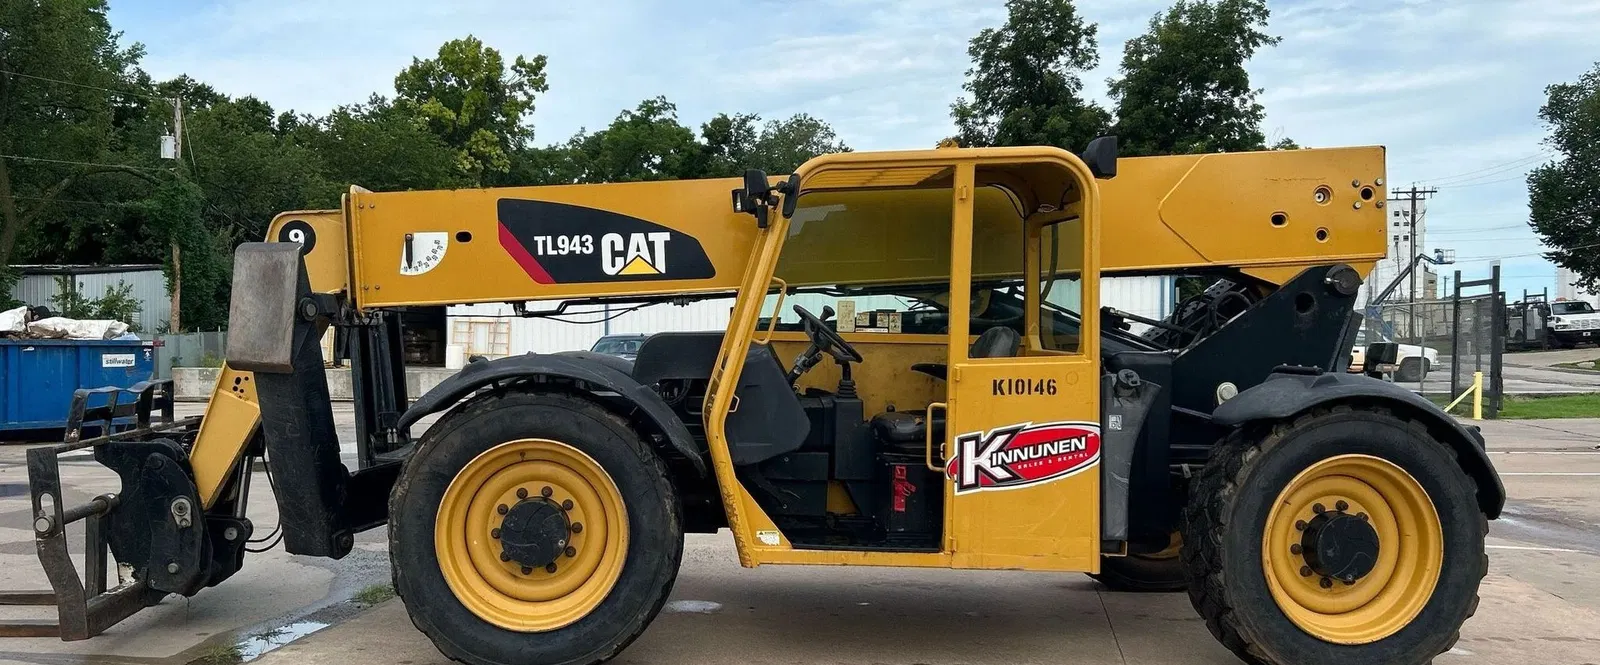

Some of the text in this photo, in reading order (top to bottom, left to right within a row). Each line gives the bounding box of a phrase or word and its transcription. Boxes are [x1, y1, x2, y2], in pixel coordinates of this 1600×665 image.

[534, 231, 671, 277] TL943 CAT
[105, 357, 134, 365] stillwater
[992, 378, 1057, 396] K10146
[960, 430, 1087, 489] KINNUNEN
